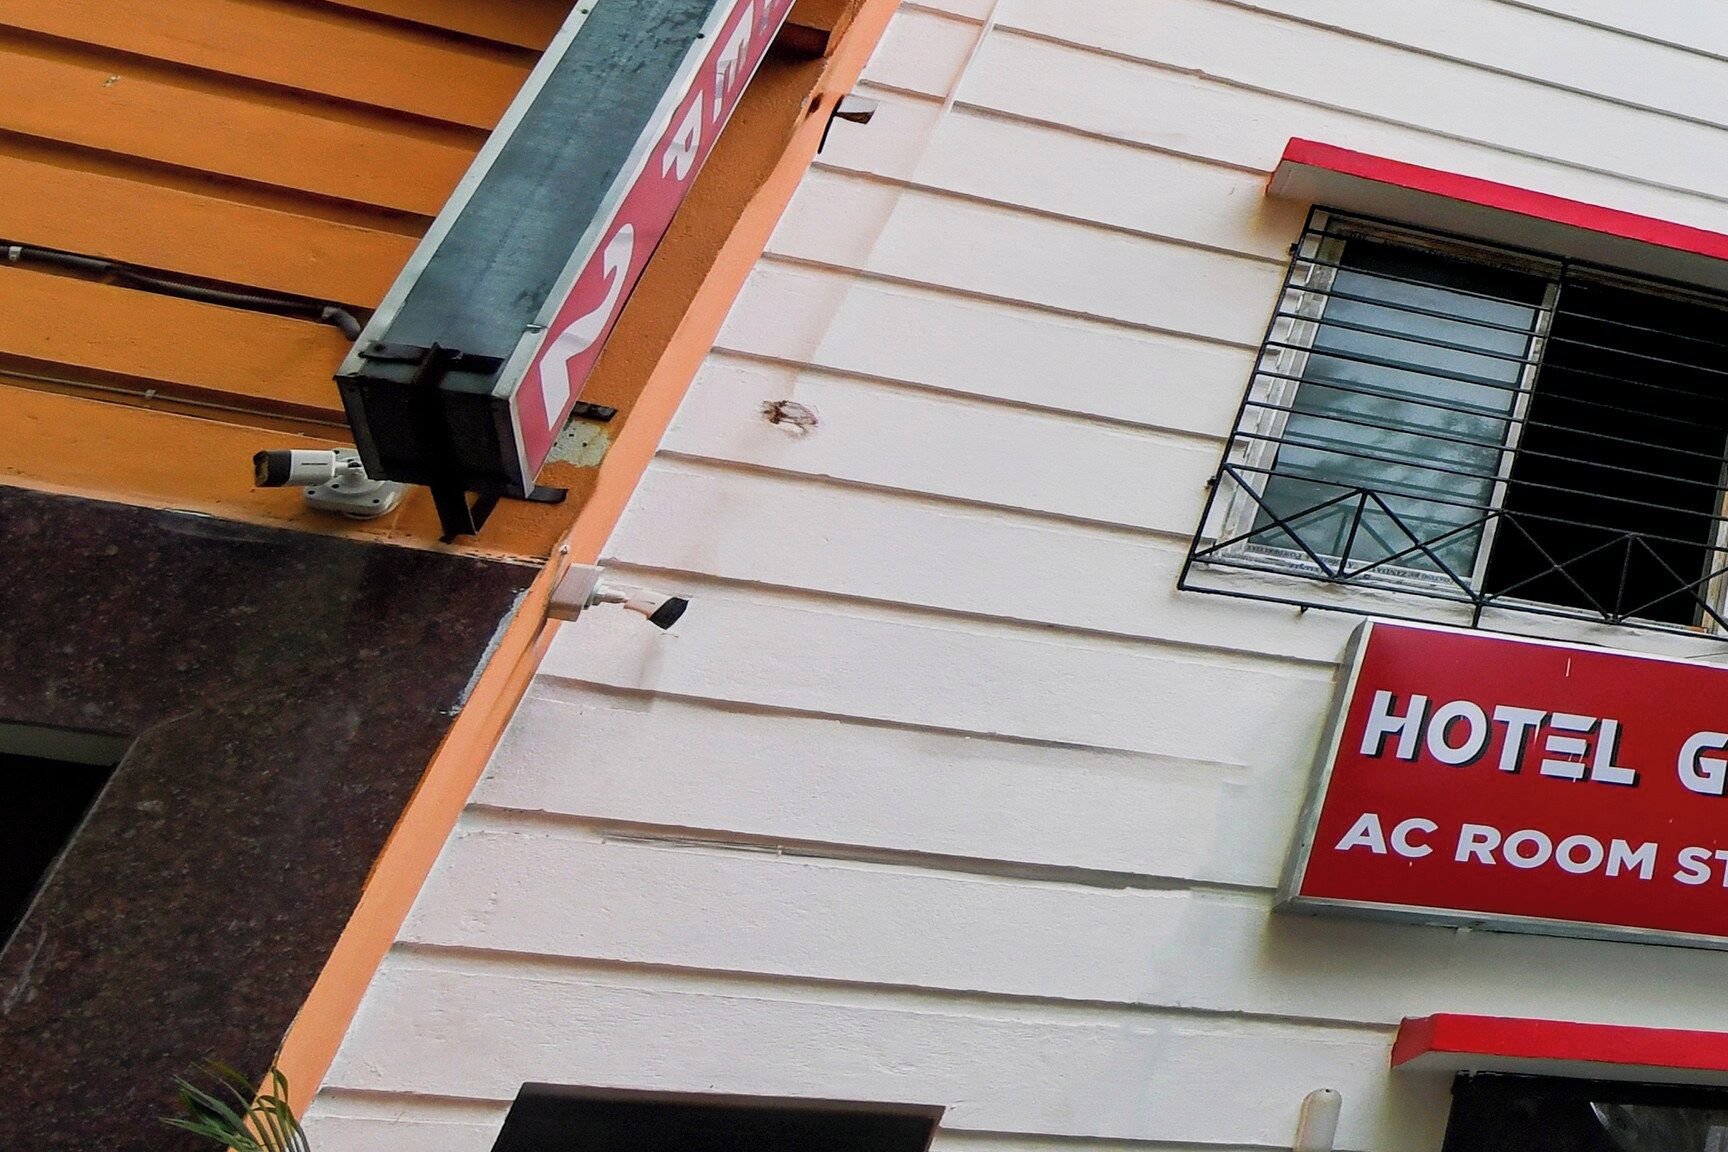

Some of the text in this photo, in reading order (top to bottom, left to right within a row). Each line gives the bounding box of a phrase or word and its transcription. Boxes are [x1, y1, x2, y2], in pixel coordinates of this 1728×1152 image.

[540, 222, 634, 432] 2
[1359, 690, 1640, 786] HOTEL
[1334, 812, 1440, 858] AC
[1455, 823, 1657, 880] ROOM
